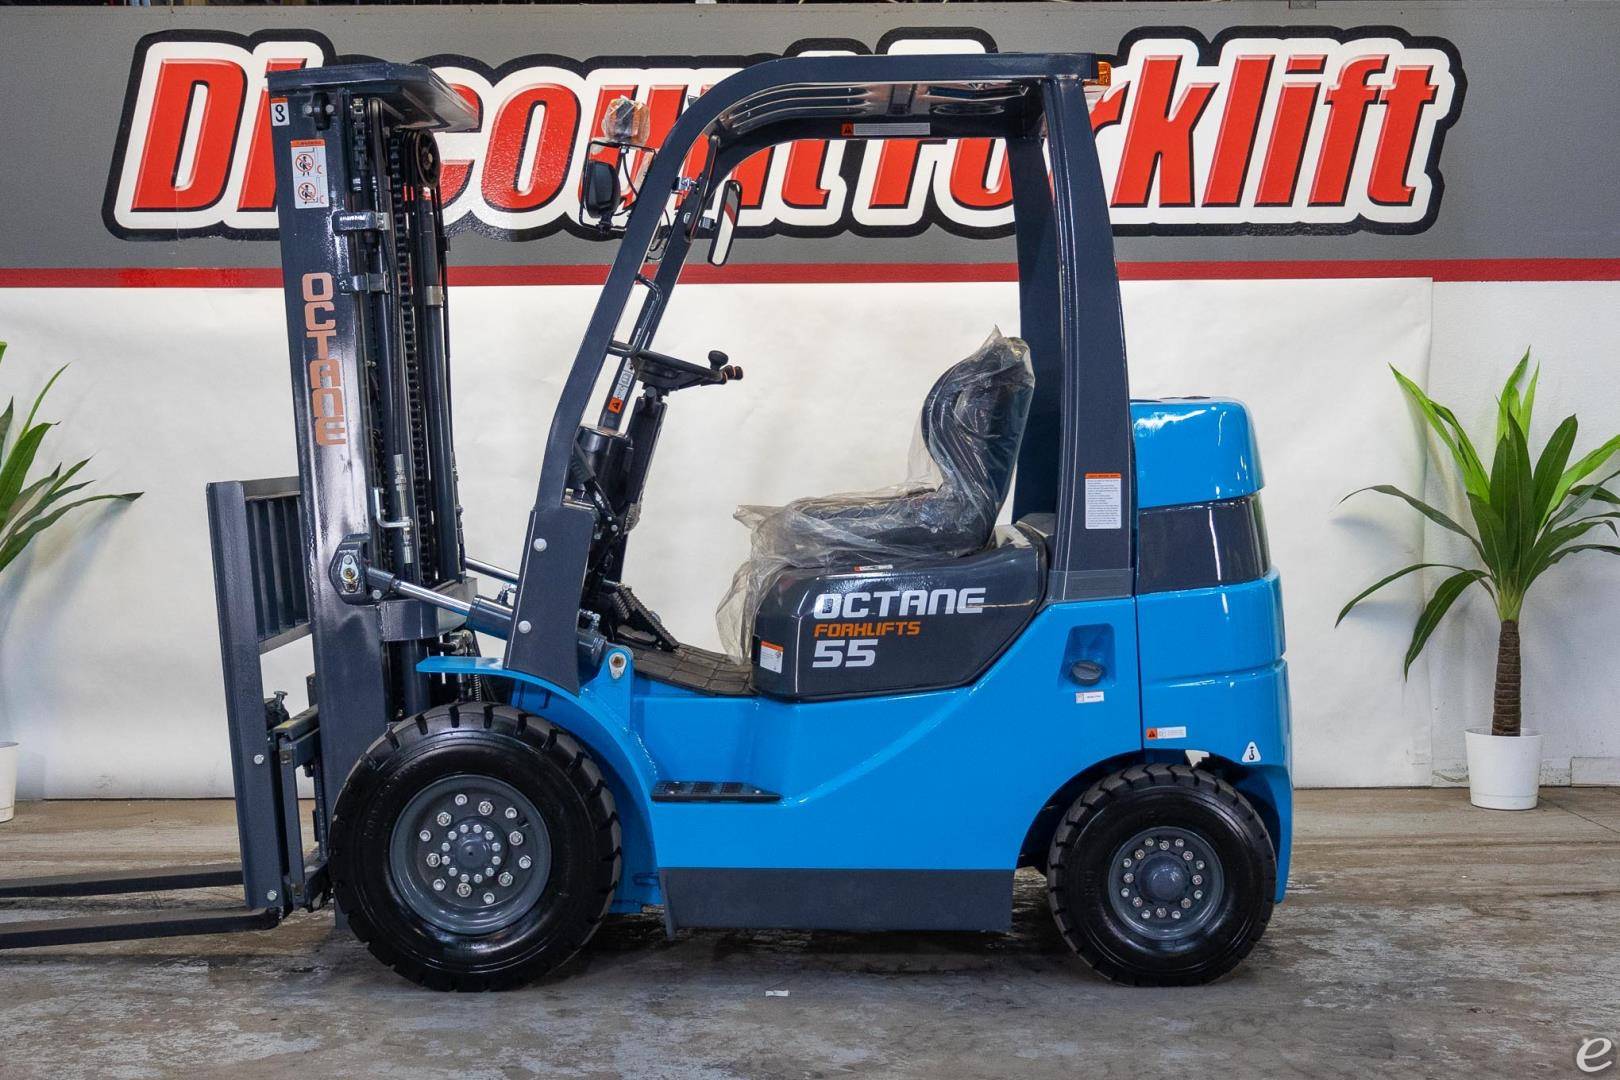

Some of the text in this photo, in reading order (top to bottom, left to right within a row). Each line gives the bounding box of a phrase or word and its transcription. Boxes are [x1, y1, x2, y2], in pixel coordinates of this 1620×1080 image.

[129, 52, 1439, 214] Diout klift
[301, 271, 347, 446] OCTANE
[812, 587, 987, 620] OCTANE
[813, 620, 922, 638] FORKLIFTS
[811, 638, 879, 668] 55
